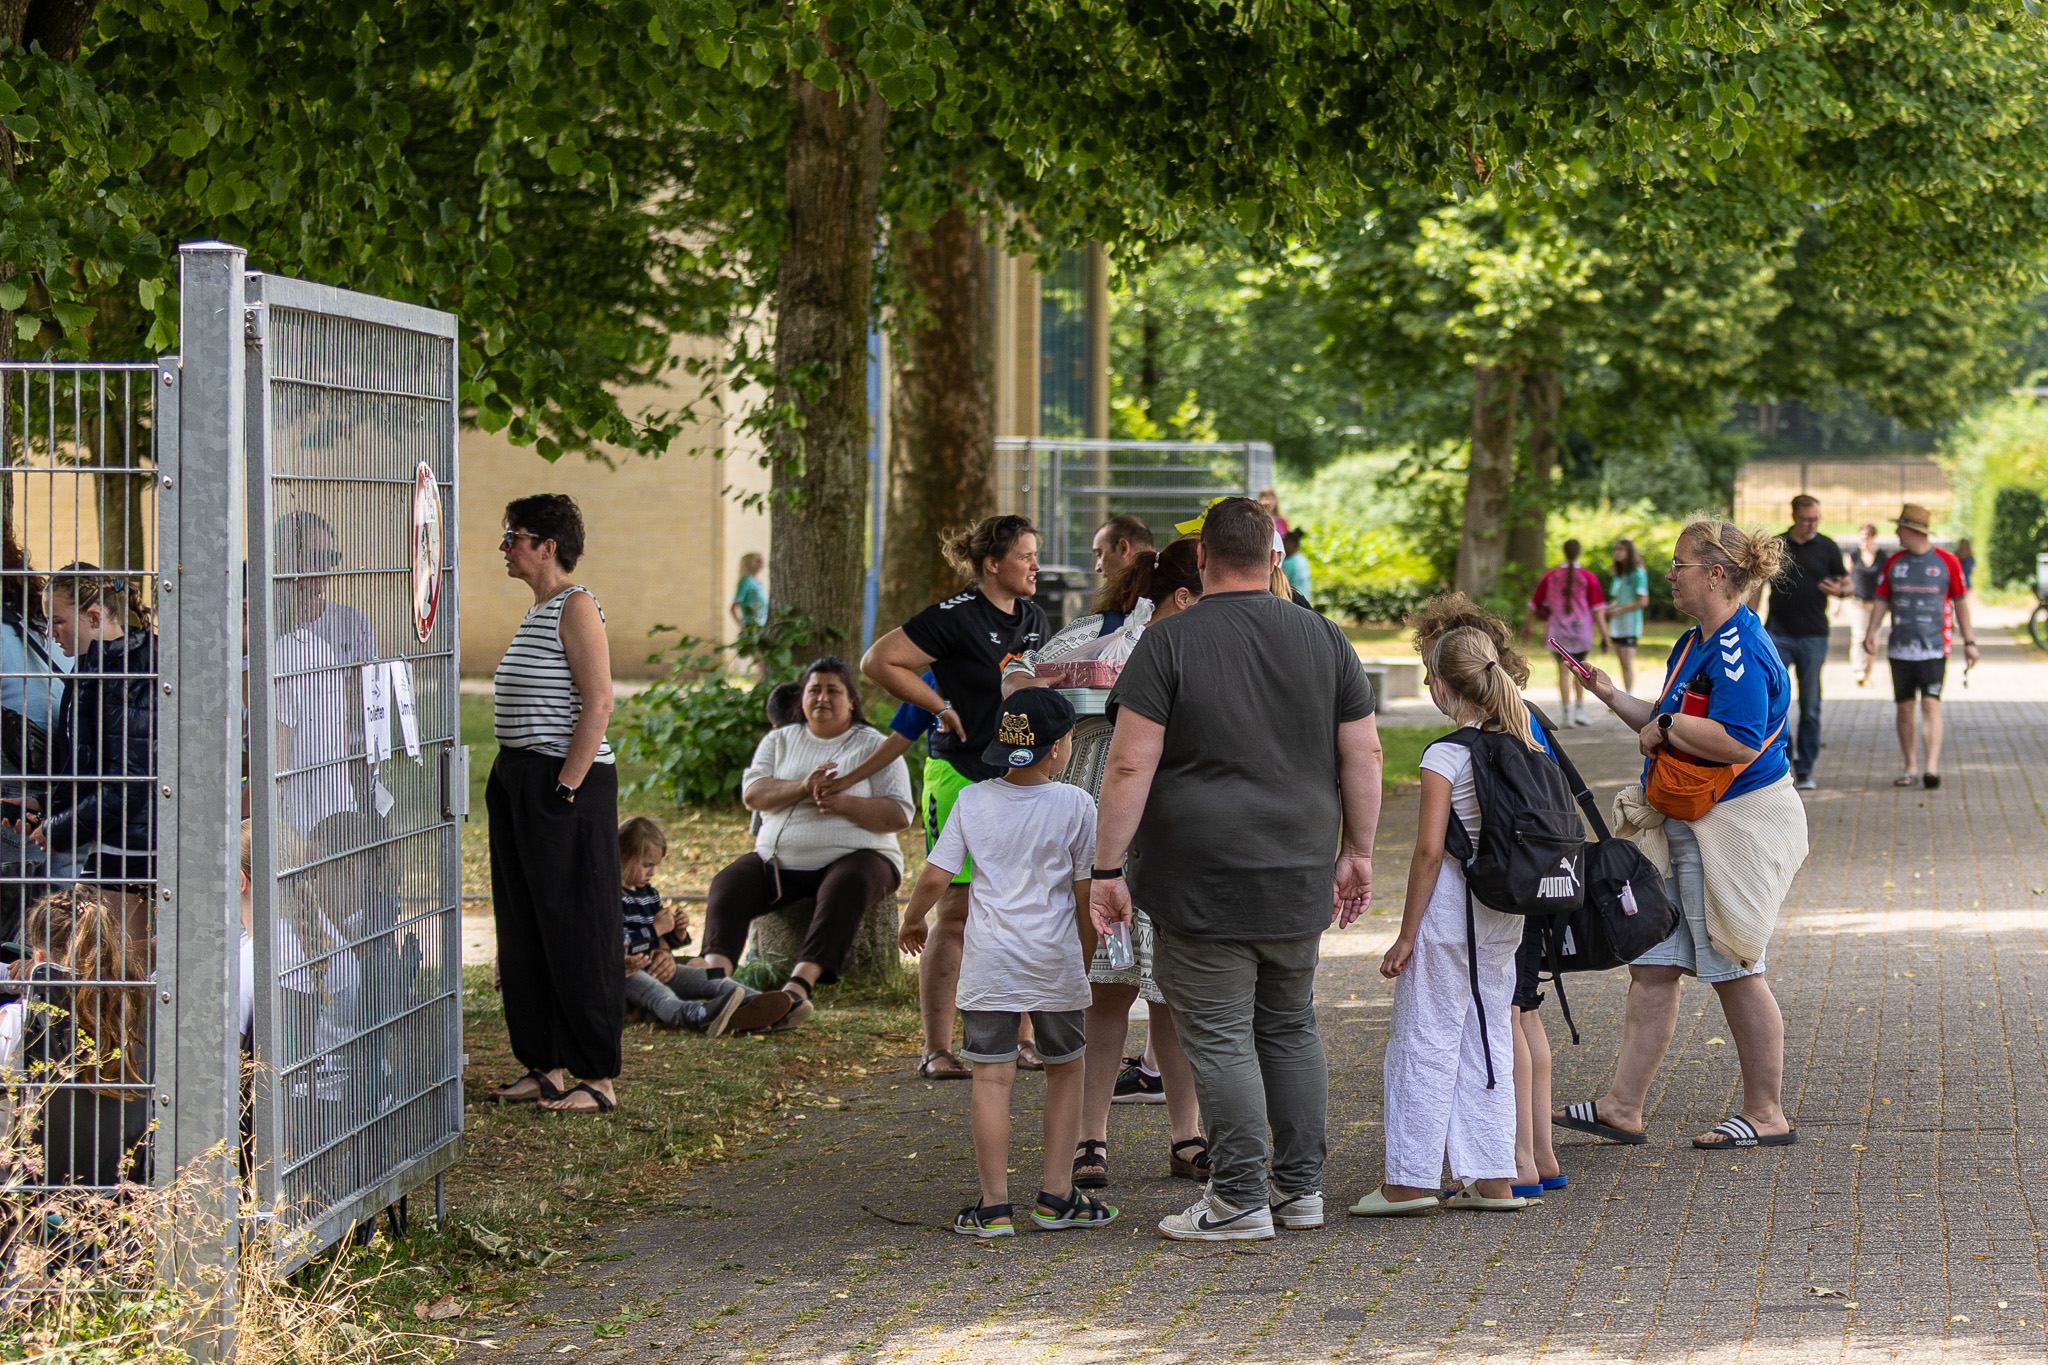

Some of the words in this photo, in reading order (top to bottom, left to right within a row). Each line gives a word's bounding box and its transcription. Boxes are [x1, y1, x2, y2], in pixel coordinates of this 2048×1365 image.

[999, 728, 1035, 746] GAMER
[1536, 876, 1575, 898] PUMA
[1735, 1138, 1759, 1146] adidas
